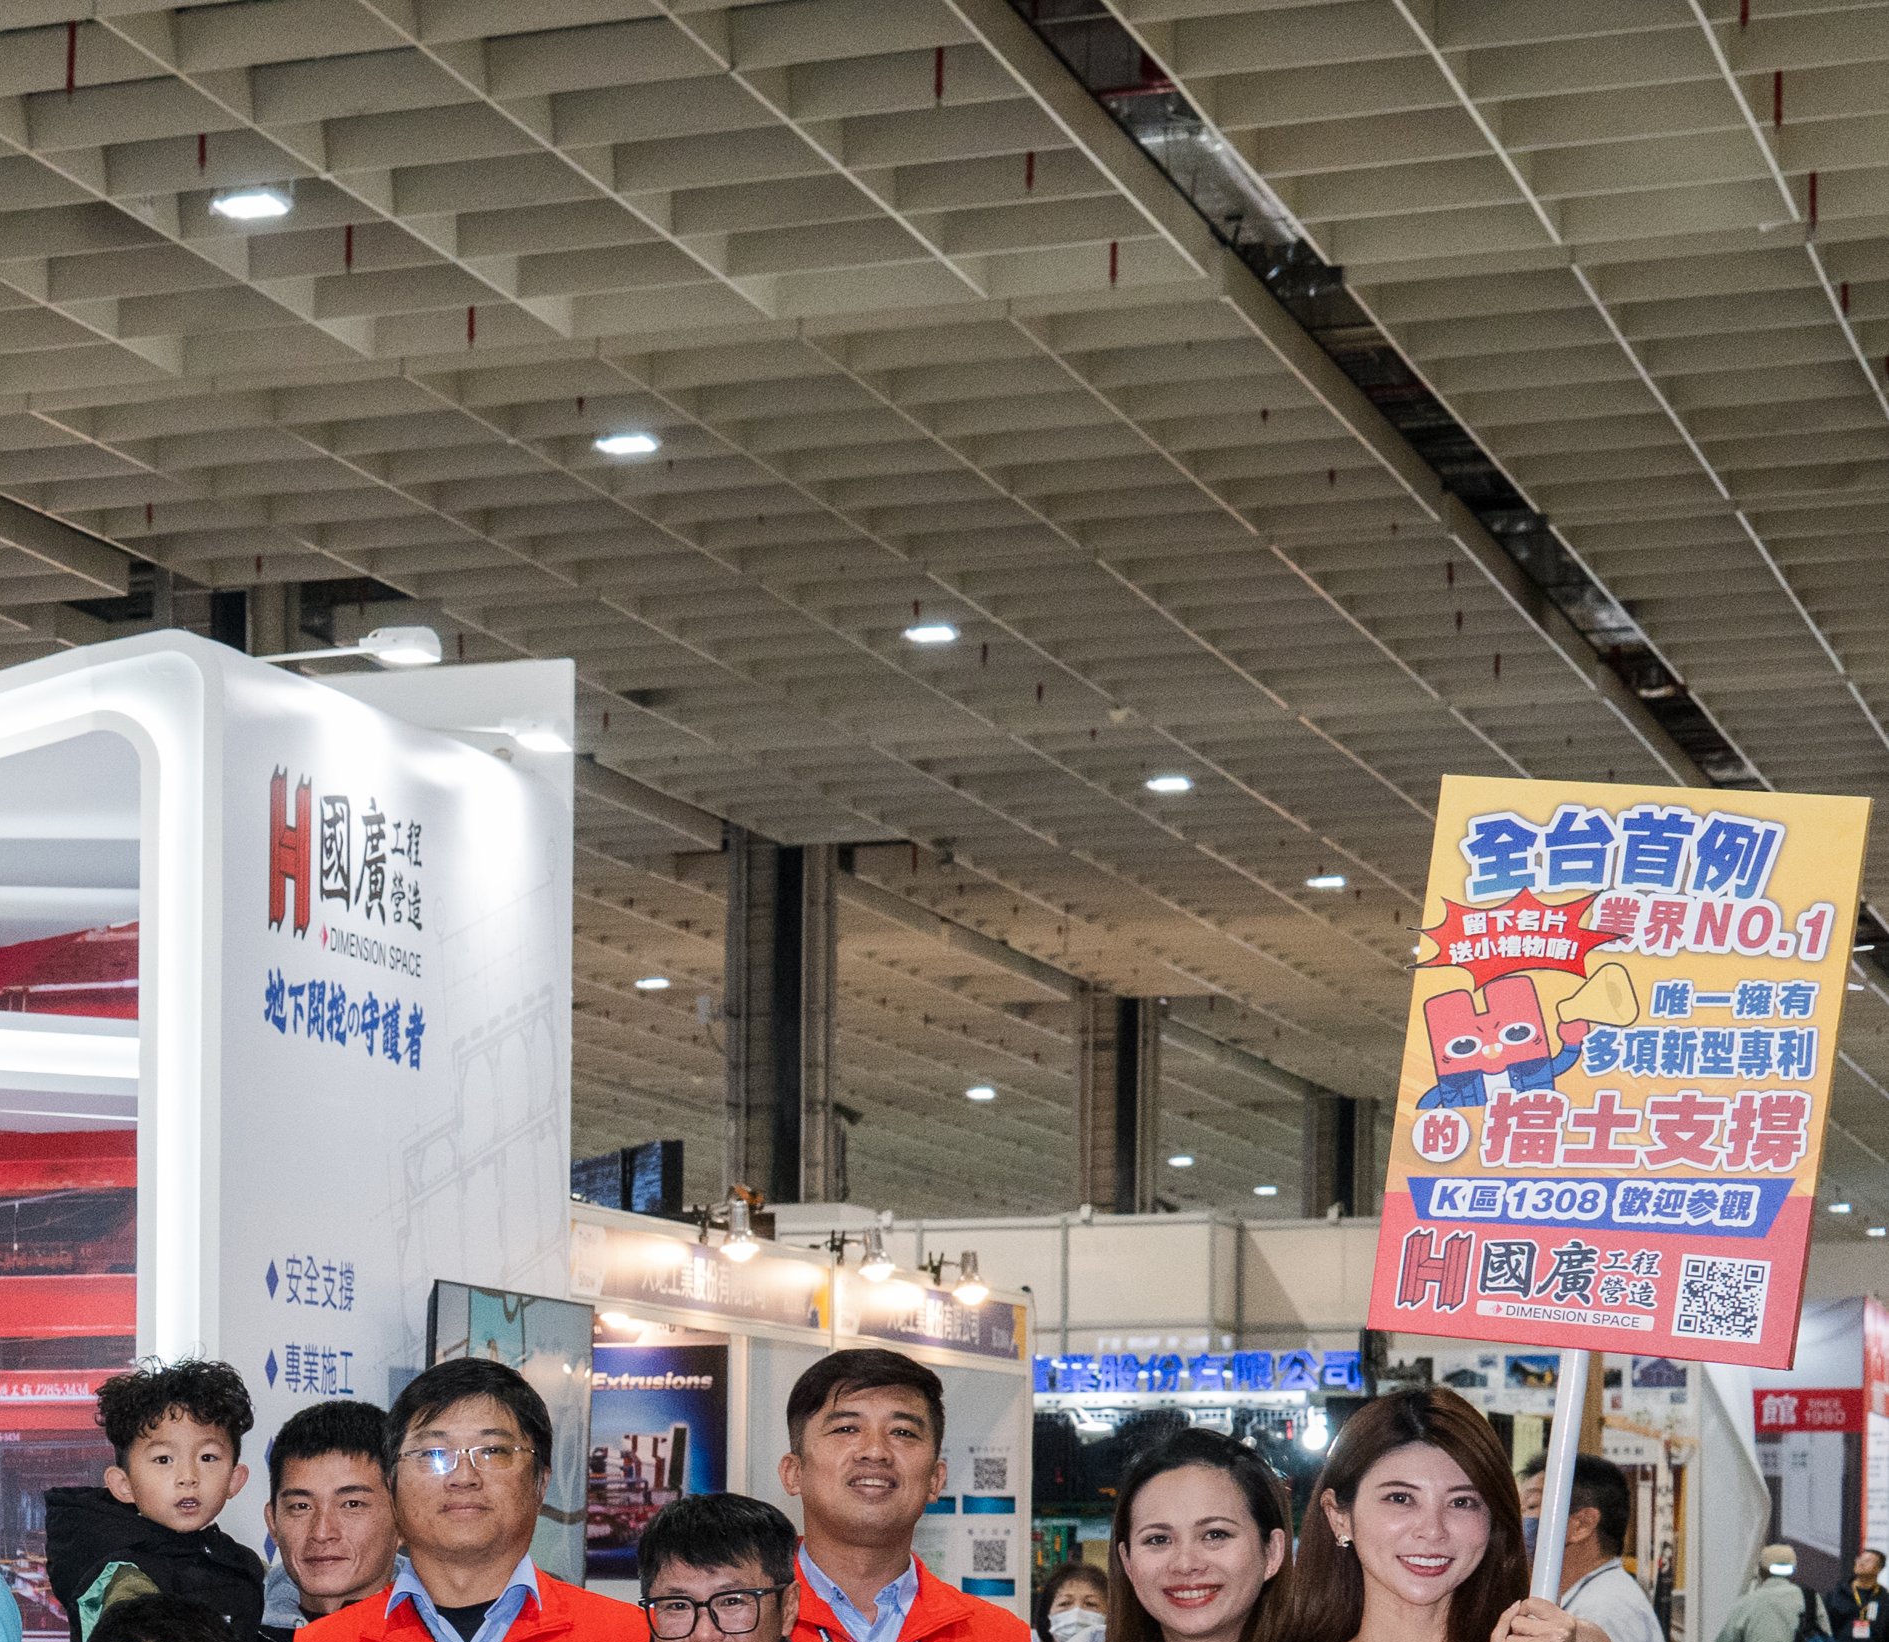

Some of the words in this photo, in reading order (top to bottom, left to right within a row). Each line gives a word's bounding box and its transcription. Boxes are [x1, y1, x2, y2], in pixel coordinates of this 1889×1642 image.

[320, 796, 388, 925] 國廣
[390, 819, 423, 867] 工程
[1466, 810, 1782, 900] 全台首例
[390, 871, 423, 931] 營造
[1461, 909, 1569, 936] 留下名片
[1598, 896, 1832, 958] 業界NO.1
[329, 927, 386, 968] DIMENSION
[388, 946, 422, 979] SPACE
[264, 966, 427, 1071] 地下開挖の守護者
[1653, 981, 1818, 1017] 唯一擁有
[1582, 1026, 1819, 1079] 多項新型專利
[1422, 1115, 1459, 1154] 的
[1482, 1092, 1807, 1169] 擋土支撐
[284, 1253, 356, 1313] 安全支撐
[1478, 1240, 1599, 1306] 國廣
[1600, 1250, 1662, 1279] 工程
[1599, 1279, 1658, 1308] 營造
[1506, 1304, 1589, 1325] DIMENSION
[1591, 1313, 1641, 1329] SPACE
[284, 1344, 355, 1397] 專業施工
[591, 1371, 714, 1392] Extrusions
[1761, 1394, 1798, 1426] 館
